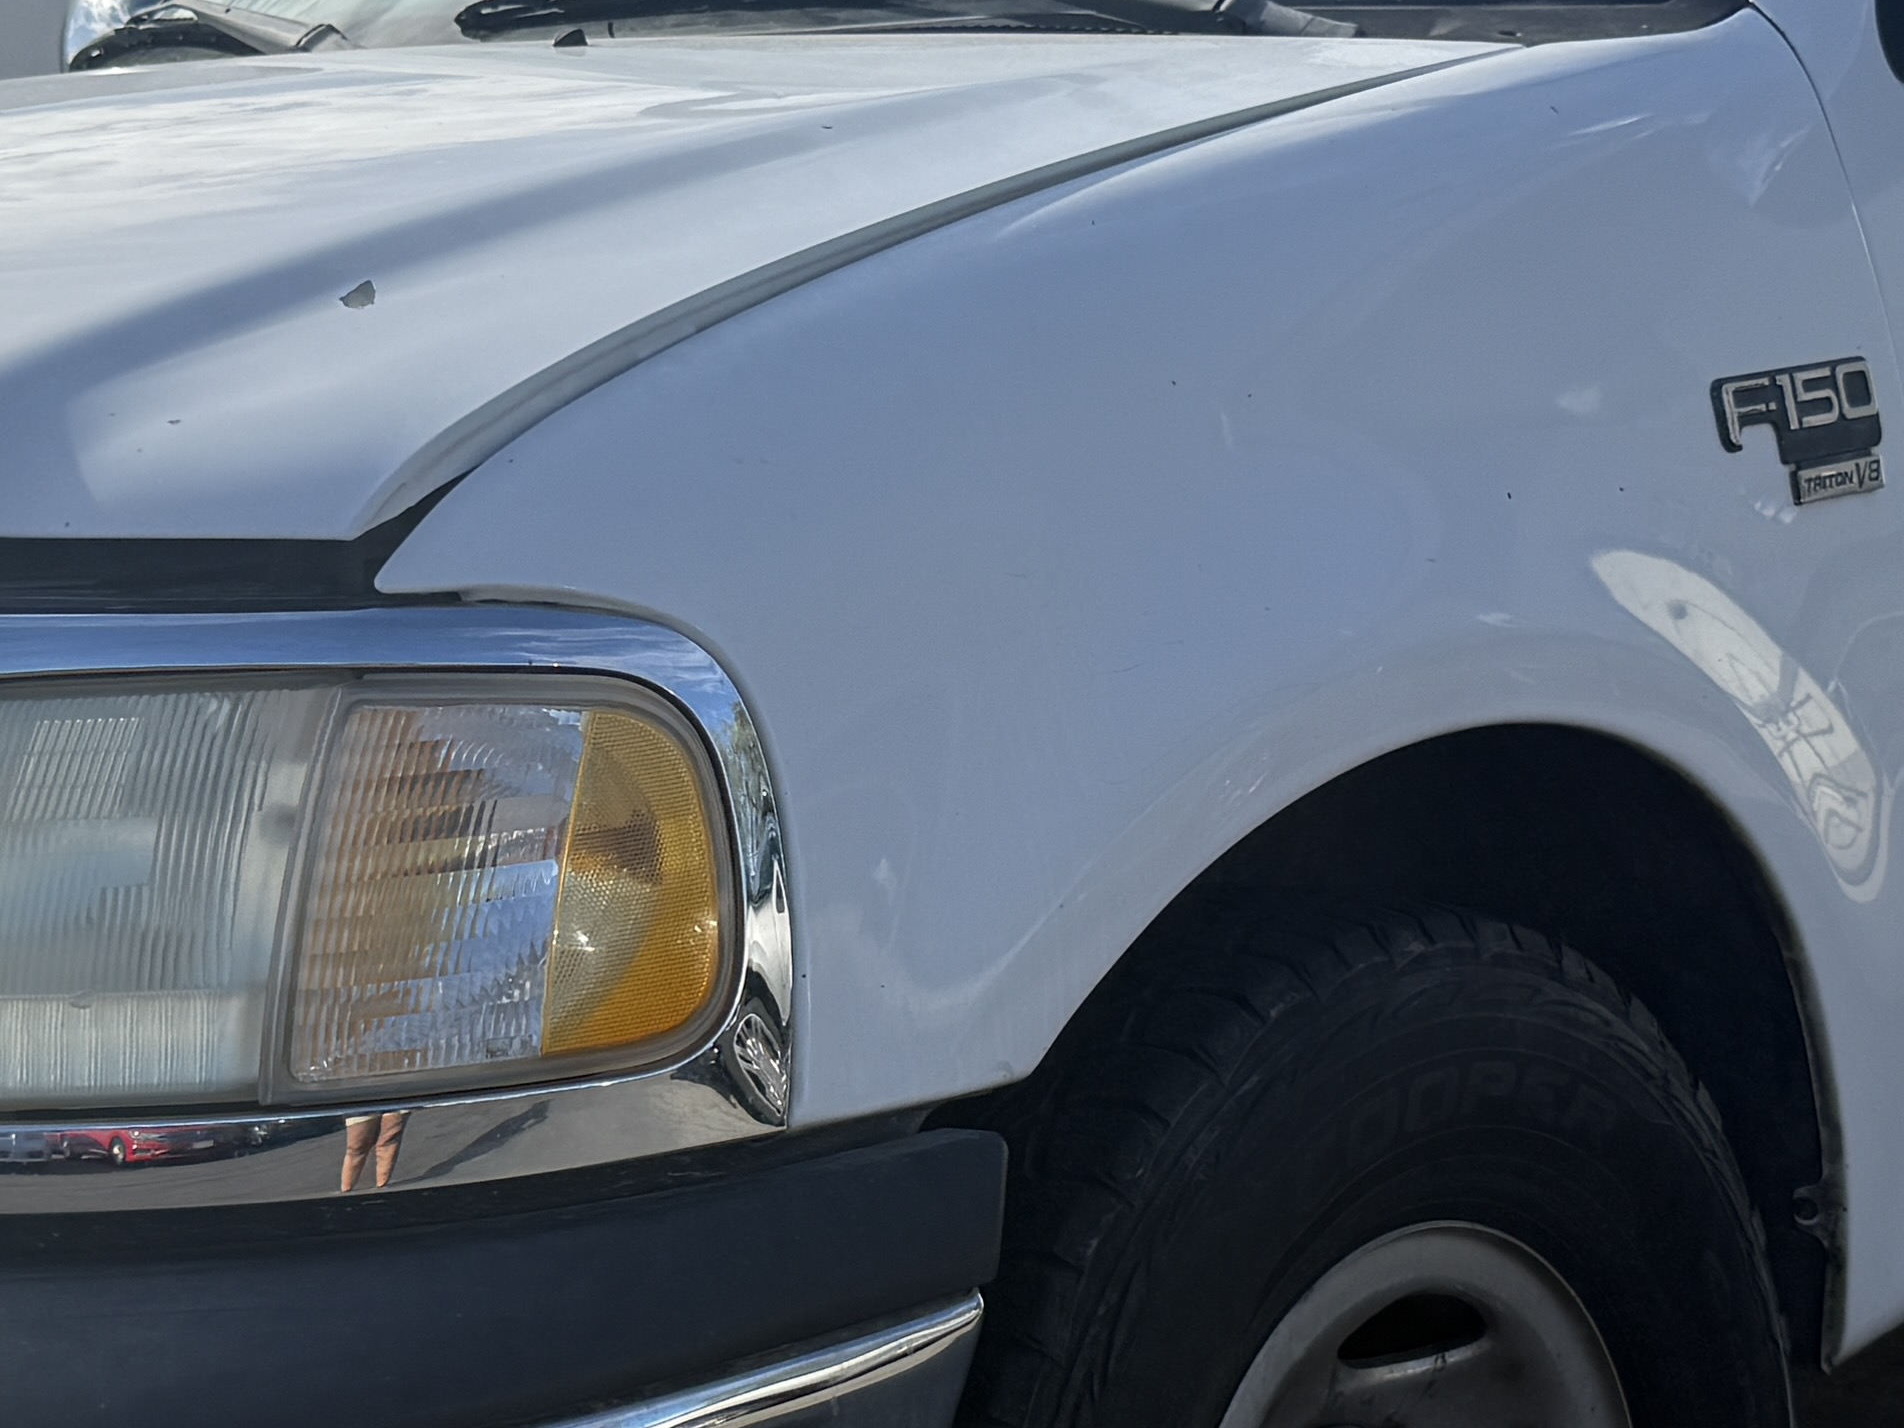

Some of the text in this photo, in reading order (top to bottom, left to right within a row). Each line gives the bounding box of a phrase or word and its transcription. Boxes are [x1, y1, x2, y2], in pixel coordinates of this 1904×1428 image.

[1721, 360, 1880, 446] F-150
[1803, 458, 1883, 494] TRITON V8
